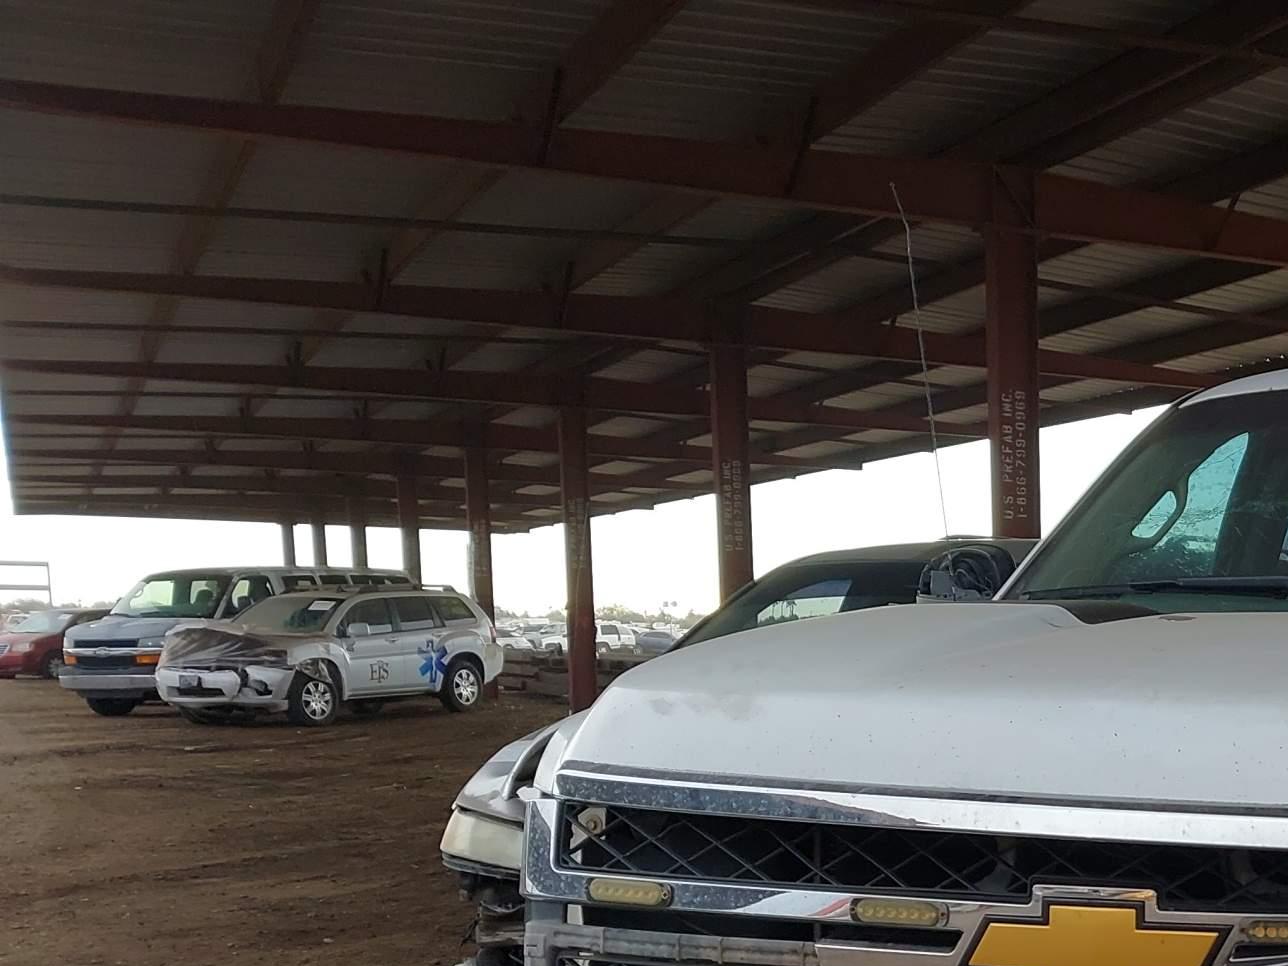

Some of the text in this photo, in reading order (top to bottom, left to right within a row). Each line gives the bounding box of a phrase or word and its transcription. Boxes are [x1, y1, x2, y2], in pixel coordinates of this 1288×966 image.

[1001, 388, 1014, 417] INC.
[1001, 424, 1014, 482] PREFAB
[1015, 390, 1028, 519] 1-866-799-0969
